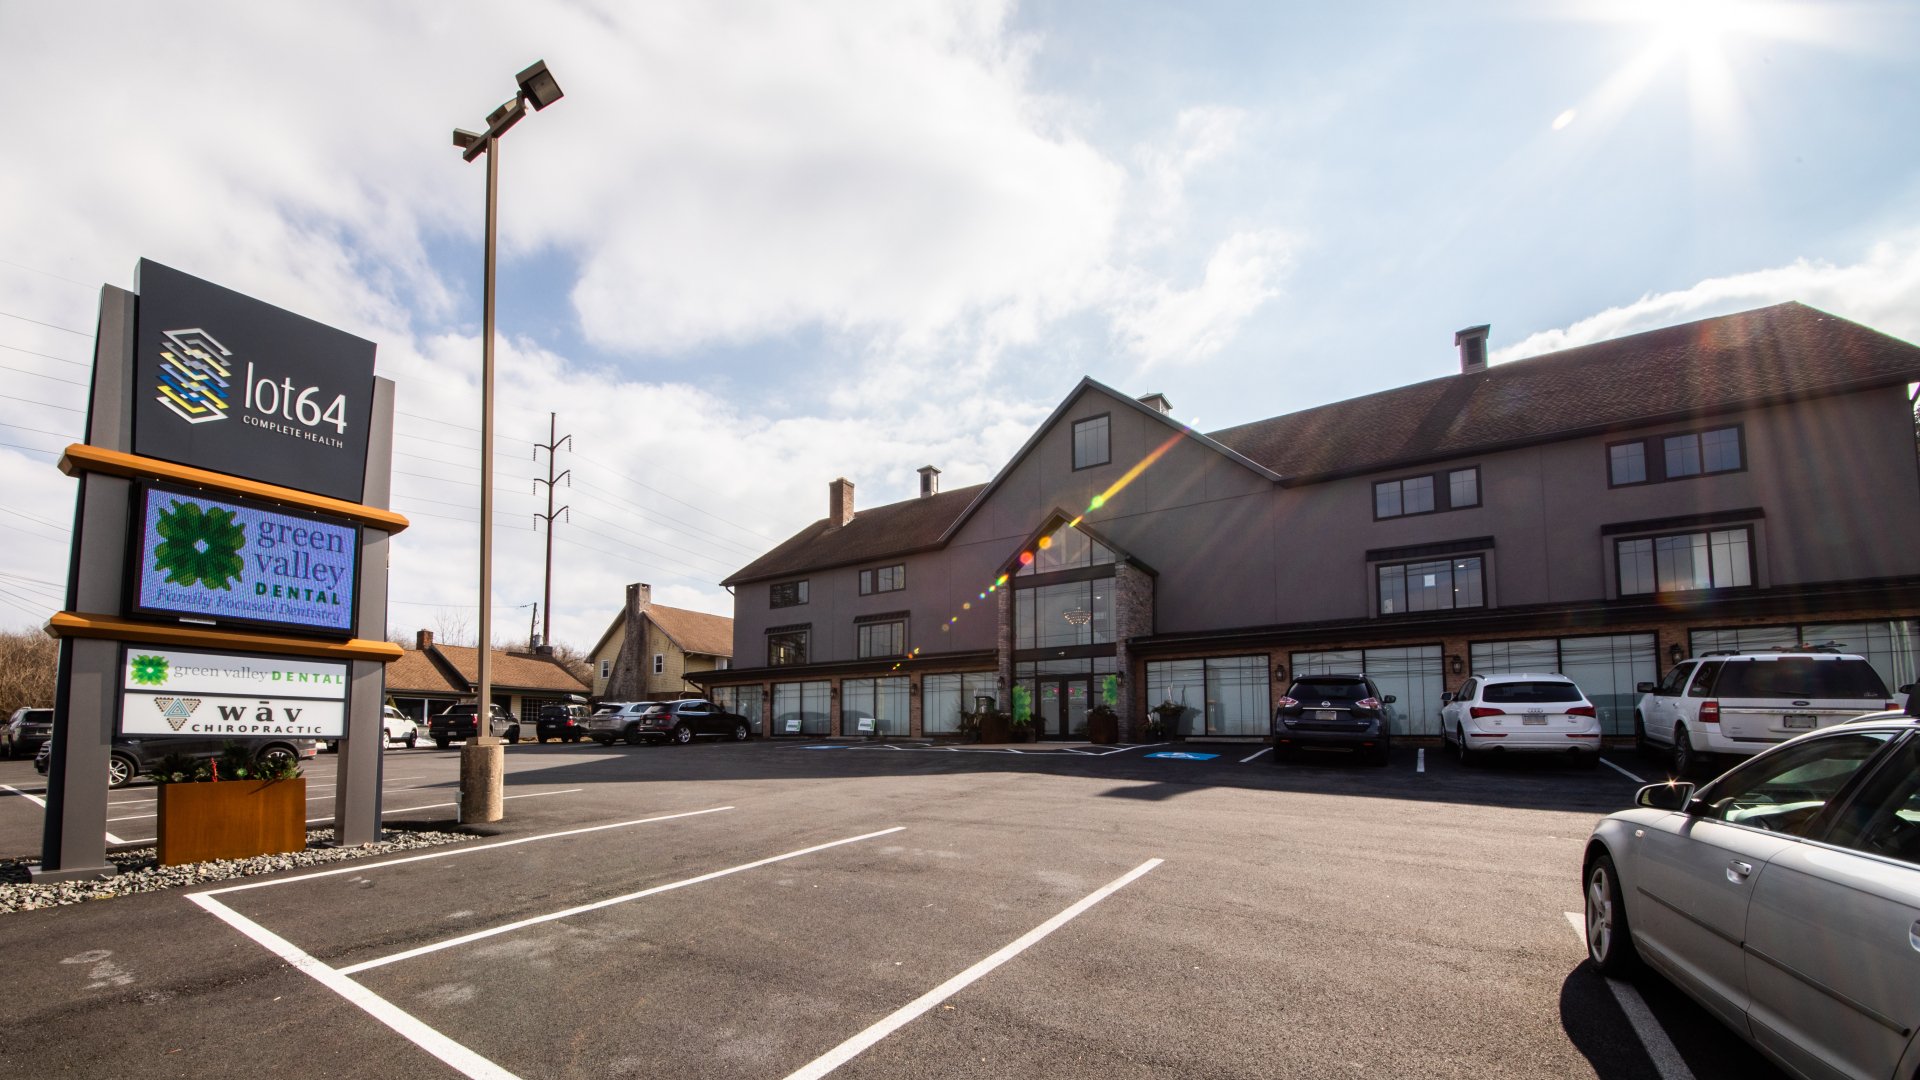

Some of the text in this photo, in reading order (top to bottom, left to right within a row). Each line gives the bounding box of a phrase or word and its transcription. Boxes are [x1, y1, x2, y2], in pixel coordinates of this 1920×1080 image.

[244, 361, 347, 435] lot64
[243, 415, 344, 449] COMPLETE HEALTH
[257, 520, 345, 554] green
[254, 550, 346, 590] valley
[156, 588, 341, 623] Family Focused Dentistry
[255, 582, 341, 605] DENTAL
[174, 664, 343, 685] green valley DENTAL
[191, 724, 322, 734] CHIROPRACTIC
